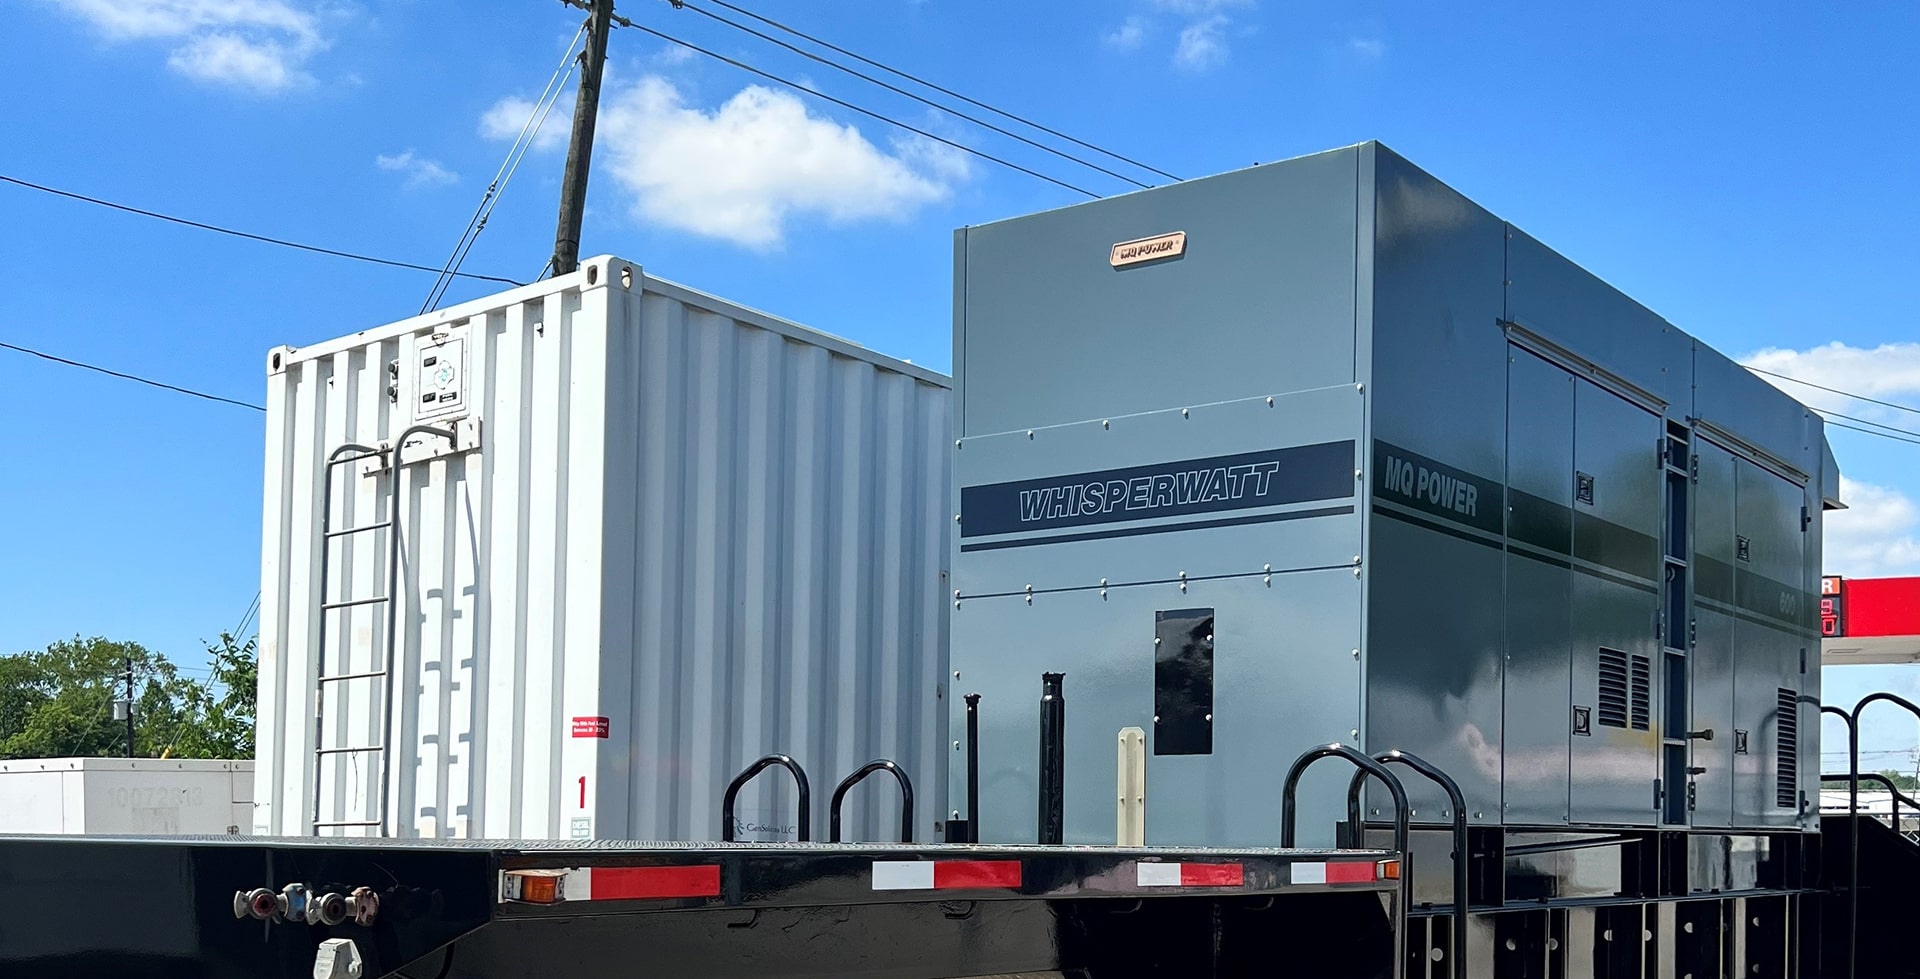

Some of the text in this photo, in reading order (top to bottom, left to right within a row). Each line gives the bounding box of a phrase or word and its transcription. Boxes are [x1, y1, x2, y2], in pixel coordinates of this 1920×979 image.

[1121, 240, 1174, 259] MQ POWER
[1019, 461, 1280, 522] WHISPERWATT
[1384, 455, 1478, 517] MQ POWER
[1780, 591, 1796, 616] 600
[578, 776, 586, 808] 1
